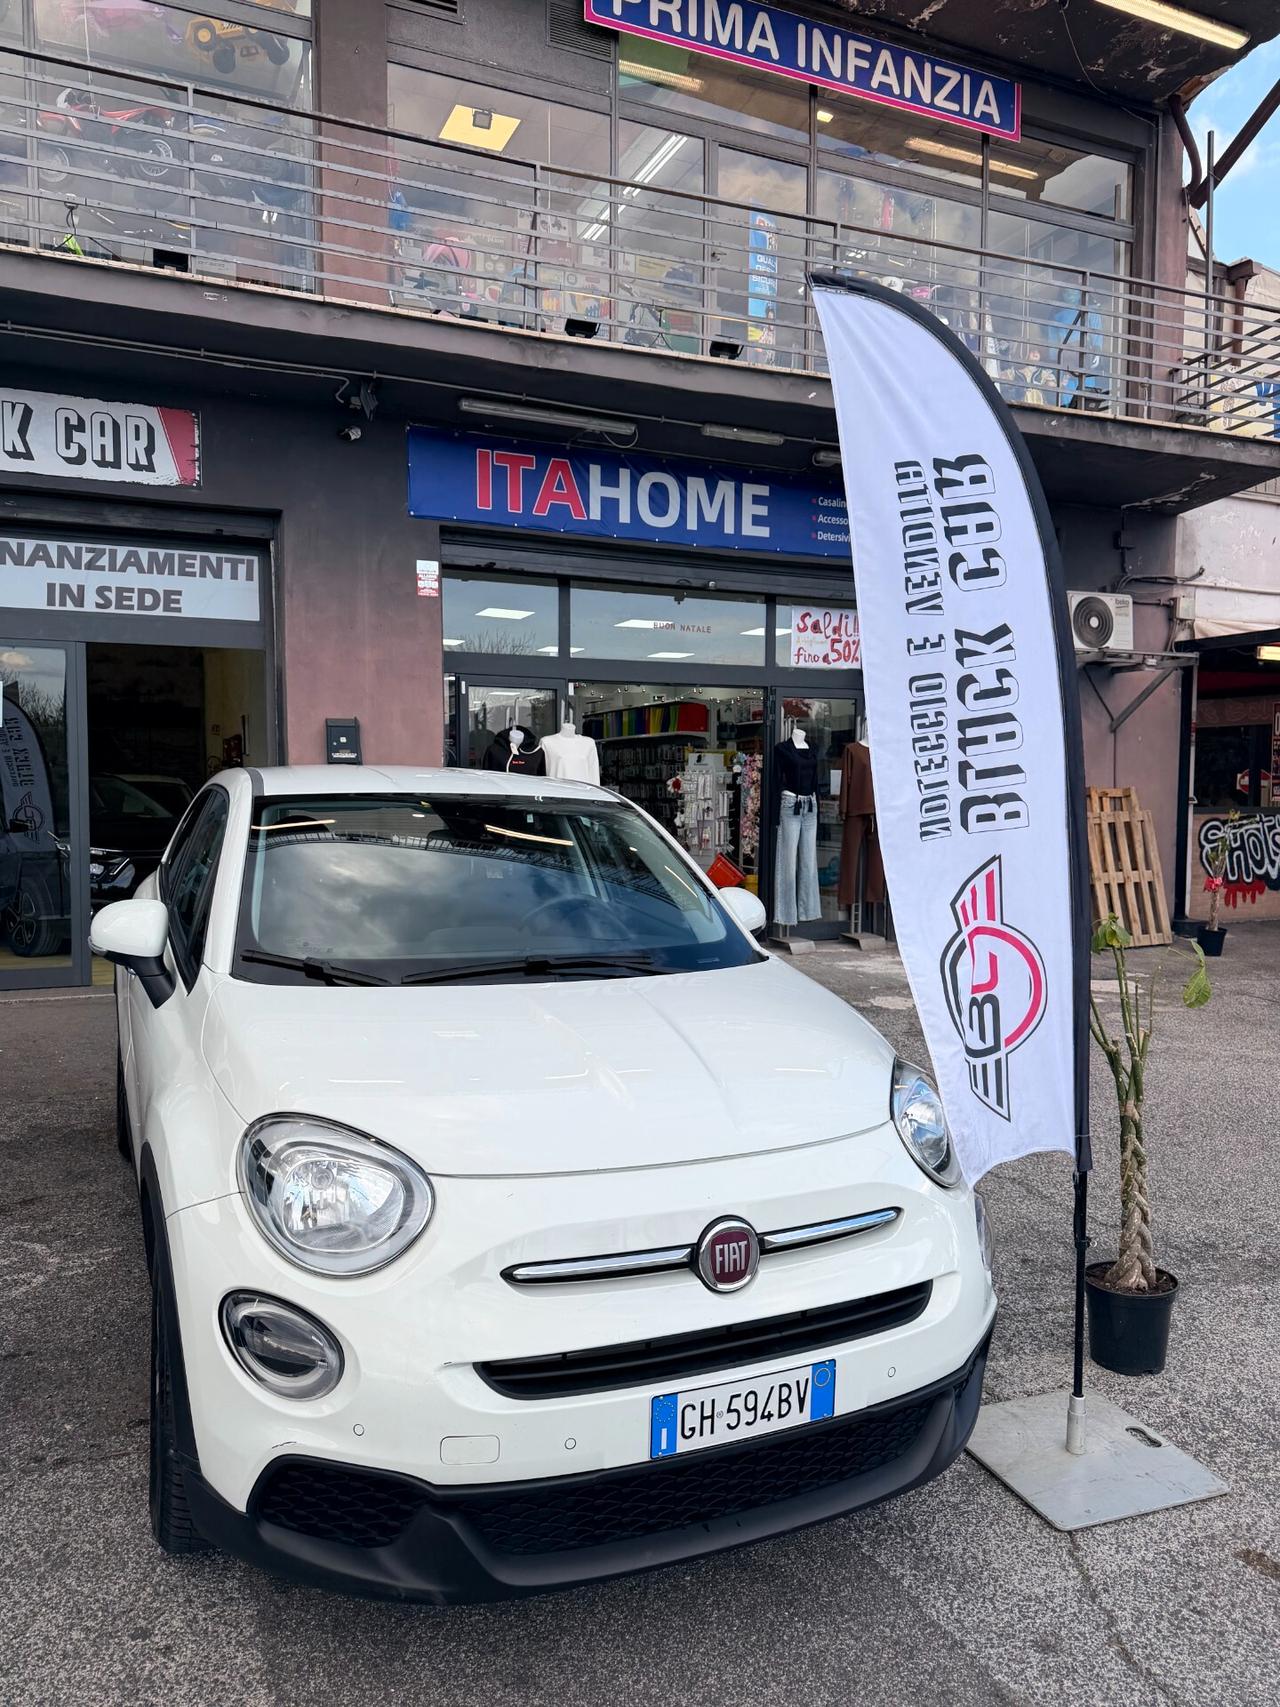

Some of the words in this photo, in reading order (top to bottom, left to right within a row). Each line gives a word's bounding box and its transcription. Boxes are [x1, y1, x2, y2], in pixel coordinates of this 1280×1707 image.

[797, 23, 1001, 124] INFANZIA
[55, 407, 157, 473] CAR
[476, 448, 770, 538] ITAHOME
[46, 582, 86, 608] IN
[95, 585, 183, 613] SEDE
[679, 624, 713, 634] NATALE
[794, 646, 821, 665] fino
[830, 637, 861, 664] 50%
[715, 1240, 748, 1275] FIAT
